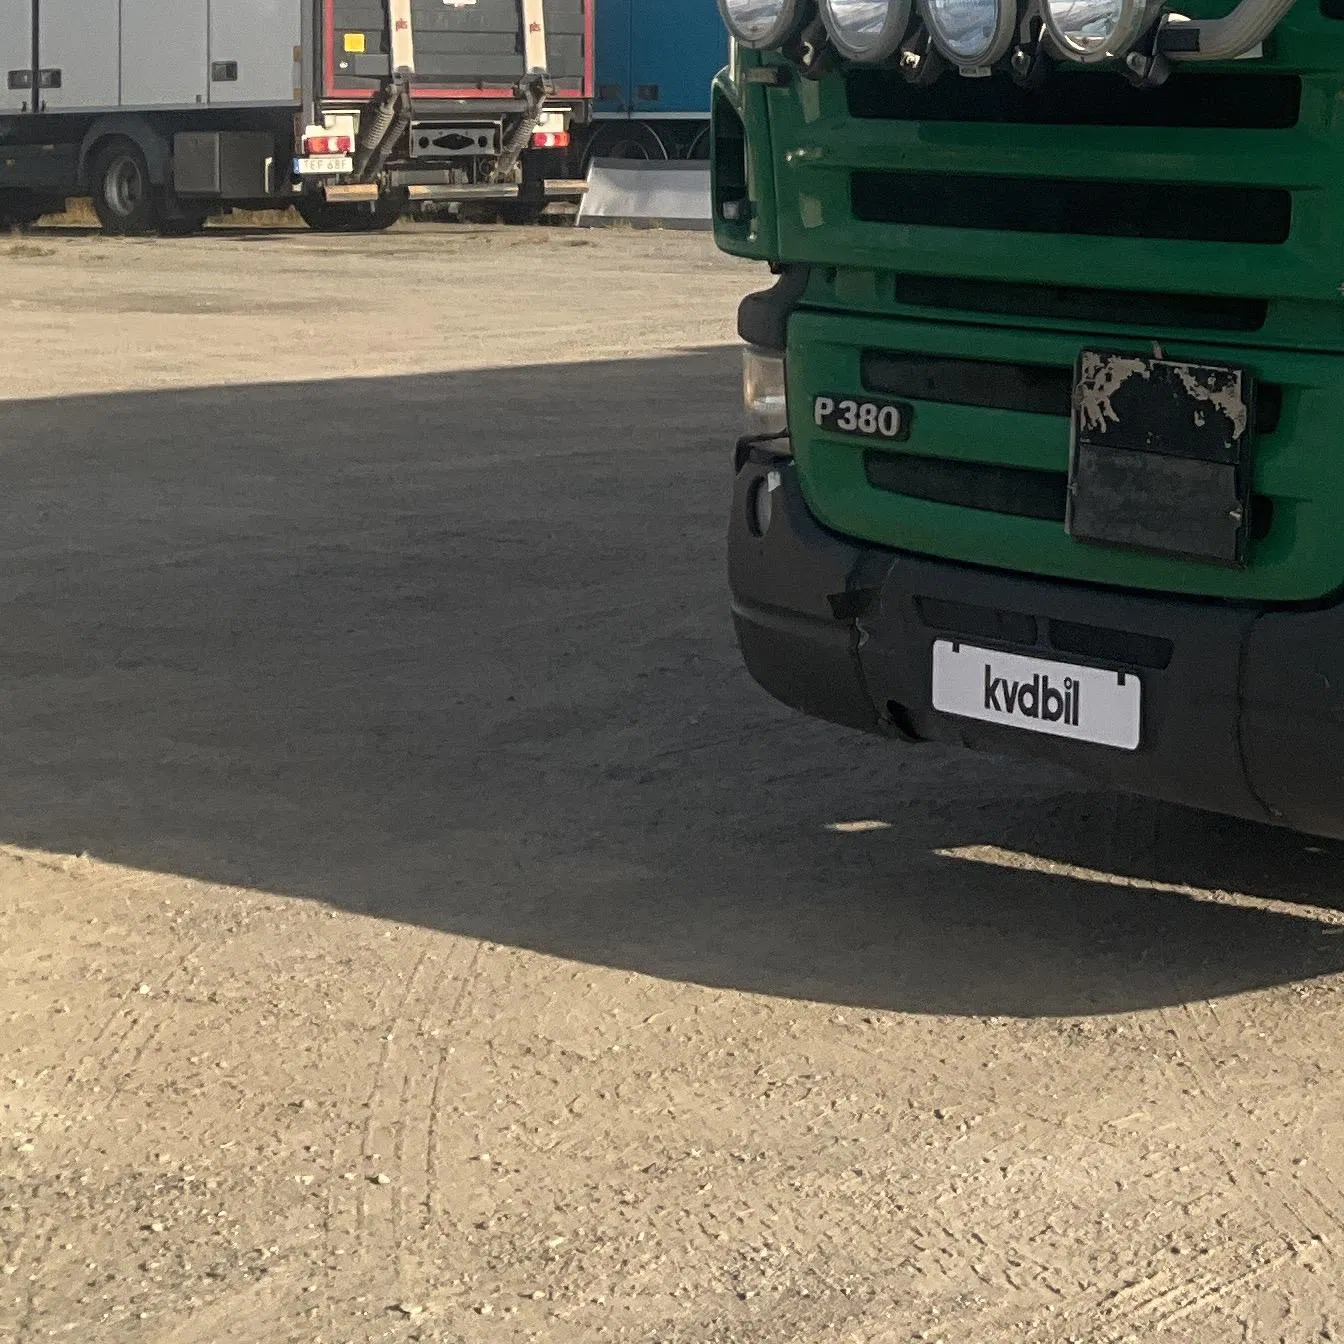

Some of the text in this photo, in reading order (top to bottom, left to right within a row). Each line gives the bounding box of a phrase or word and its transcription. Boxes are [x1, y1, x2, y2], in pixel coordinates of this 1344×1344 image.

[814, 397, 900, 436] P 380
[984, 664, 1080, 726] kvdbil
